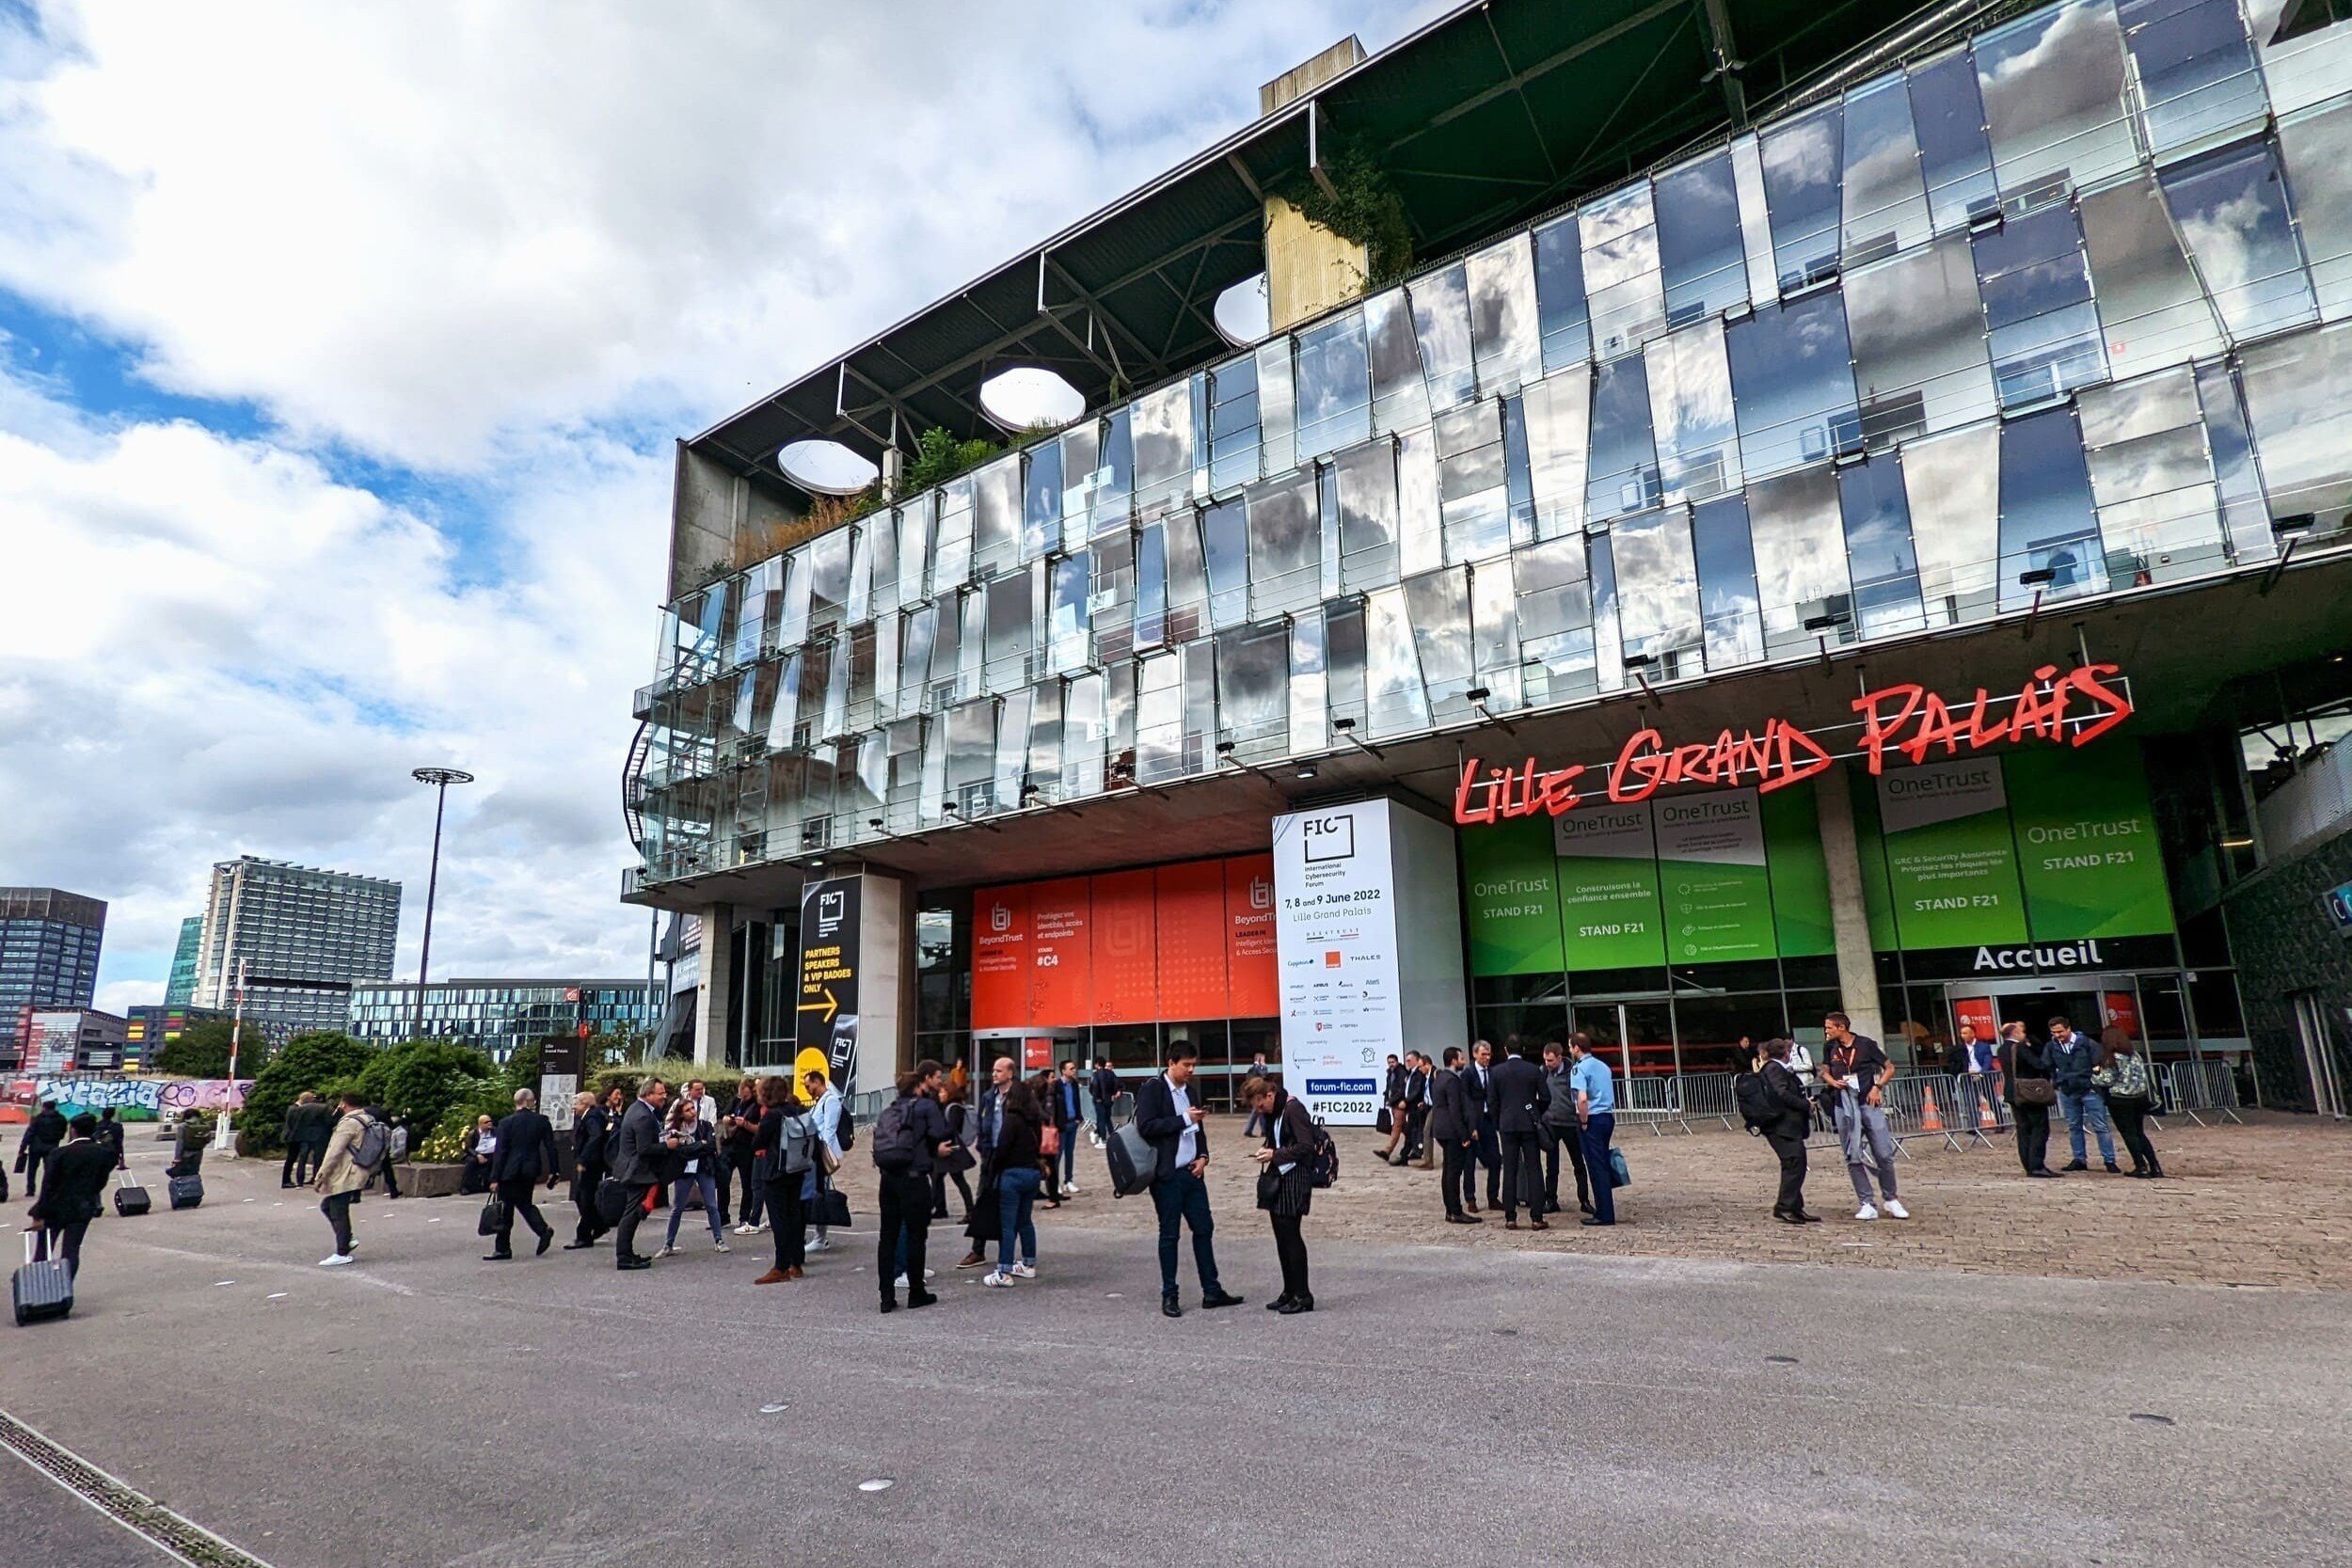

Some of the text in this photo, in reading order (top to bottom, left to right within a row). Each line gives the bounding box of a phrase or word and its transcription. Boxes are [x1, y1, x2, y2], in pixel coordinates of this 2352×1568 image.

[1889, 770, 1991, 794] OneTrust
[1663, 800, 1750, 821] OneTrust
[1304, 817, 1338, 836] FIC
[1563, 814, 1643, 833] OneTrust
[2027, 818, 2142, 844] OneTrust
[2042, 850, 2134, 870] STAND F21
[1304, 863, 1342, 872] International
[1305, 870, 1346, 880] Cybersecurity
[1475, 878, 1549, 896] OneTrust
[1576, 882, 1630, 894] Construisons
[819, 893, 837, 906] FIC
[1285, 899, 1293, 910] 7,
[1295, 897, 1301, 908] 8
[1316, 895, 1323, 905] 9
[1326, 893, 1351, 904] June
[1353, 889, 1381, 901] 2022
[1567, 890, 1652, 904] confiance ensemble
[1915, 895, 1998, 911] STAND F21
[1293, 907, 1372, 922] Lille Grand Palais
[1483, 905, 1543, 918] STAND F21
[1580, 922, 1645, 937] STAND F21
[979, 933, 1024, 945] BeyondTrust
[805, 945, 841, 959] PARTNERS
[1974, 940, 2104, 970] Accueil
[804, 958, 840, 971] SPEAKERS
[1037, 955, 1058, 966] #C4
[811, 971, 822, 981] VIP
[823, 969, 851, 980] BADGES
[803, 983, 822, 993] ONLY
[835, 1037, 847, 1047] FIC
[1311, 1082, 1373, 1092] forum-fic.com
[1312, 1101, 1373, 1113] #FIC2022
